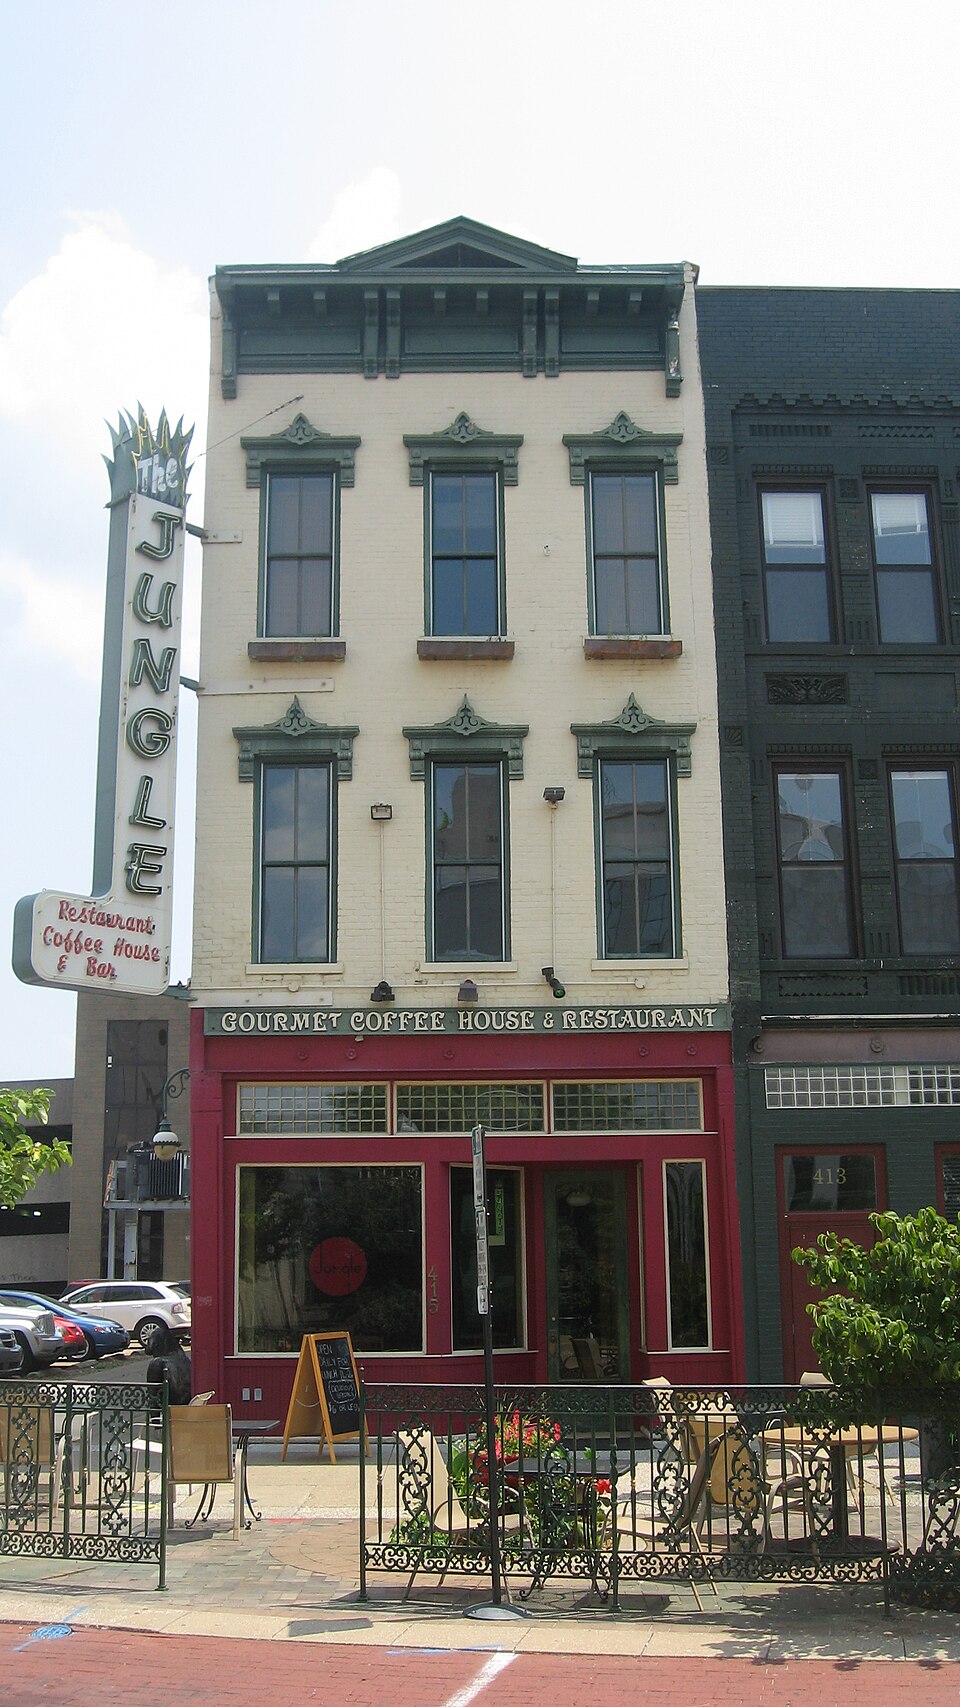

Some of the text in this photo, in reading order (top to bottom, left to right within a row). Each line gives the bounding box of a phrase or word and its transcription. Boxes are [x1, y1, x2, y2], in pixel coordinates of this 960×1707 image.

[138, 454, 179, 494] The
[124, 511, 183, 895] JUNGLE
[58, 899, 155, 935] Restaurant
[43, 926, 160, 963] Coffee House
[86, 956, 117, 979] Bar
[221, 1008, 717, 1032] GOURMET COFFEE HOUSE & RESTAURANT
[813, 1168, 847, 1185] 413
[428, 1265, 439, 1314] 415
